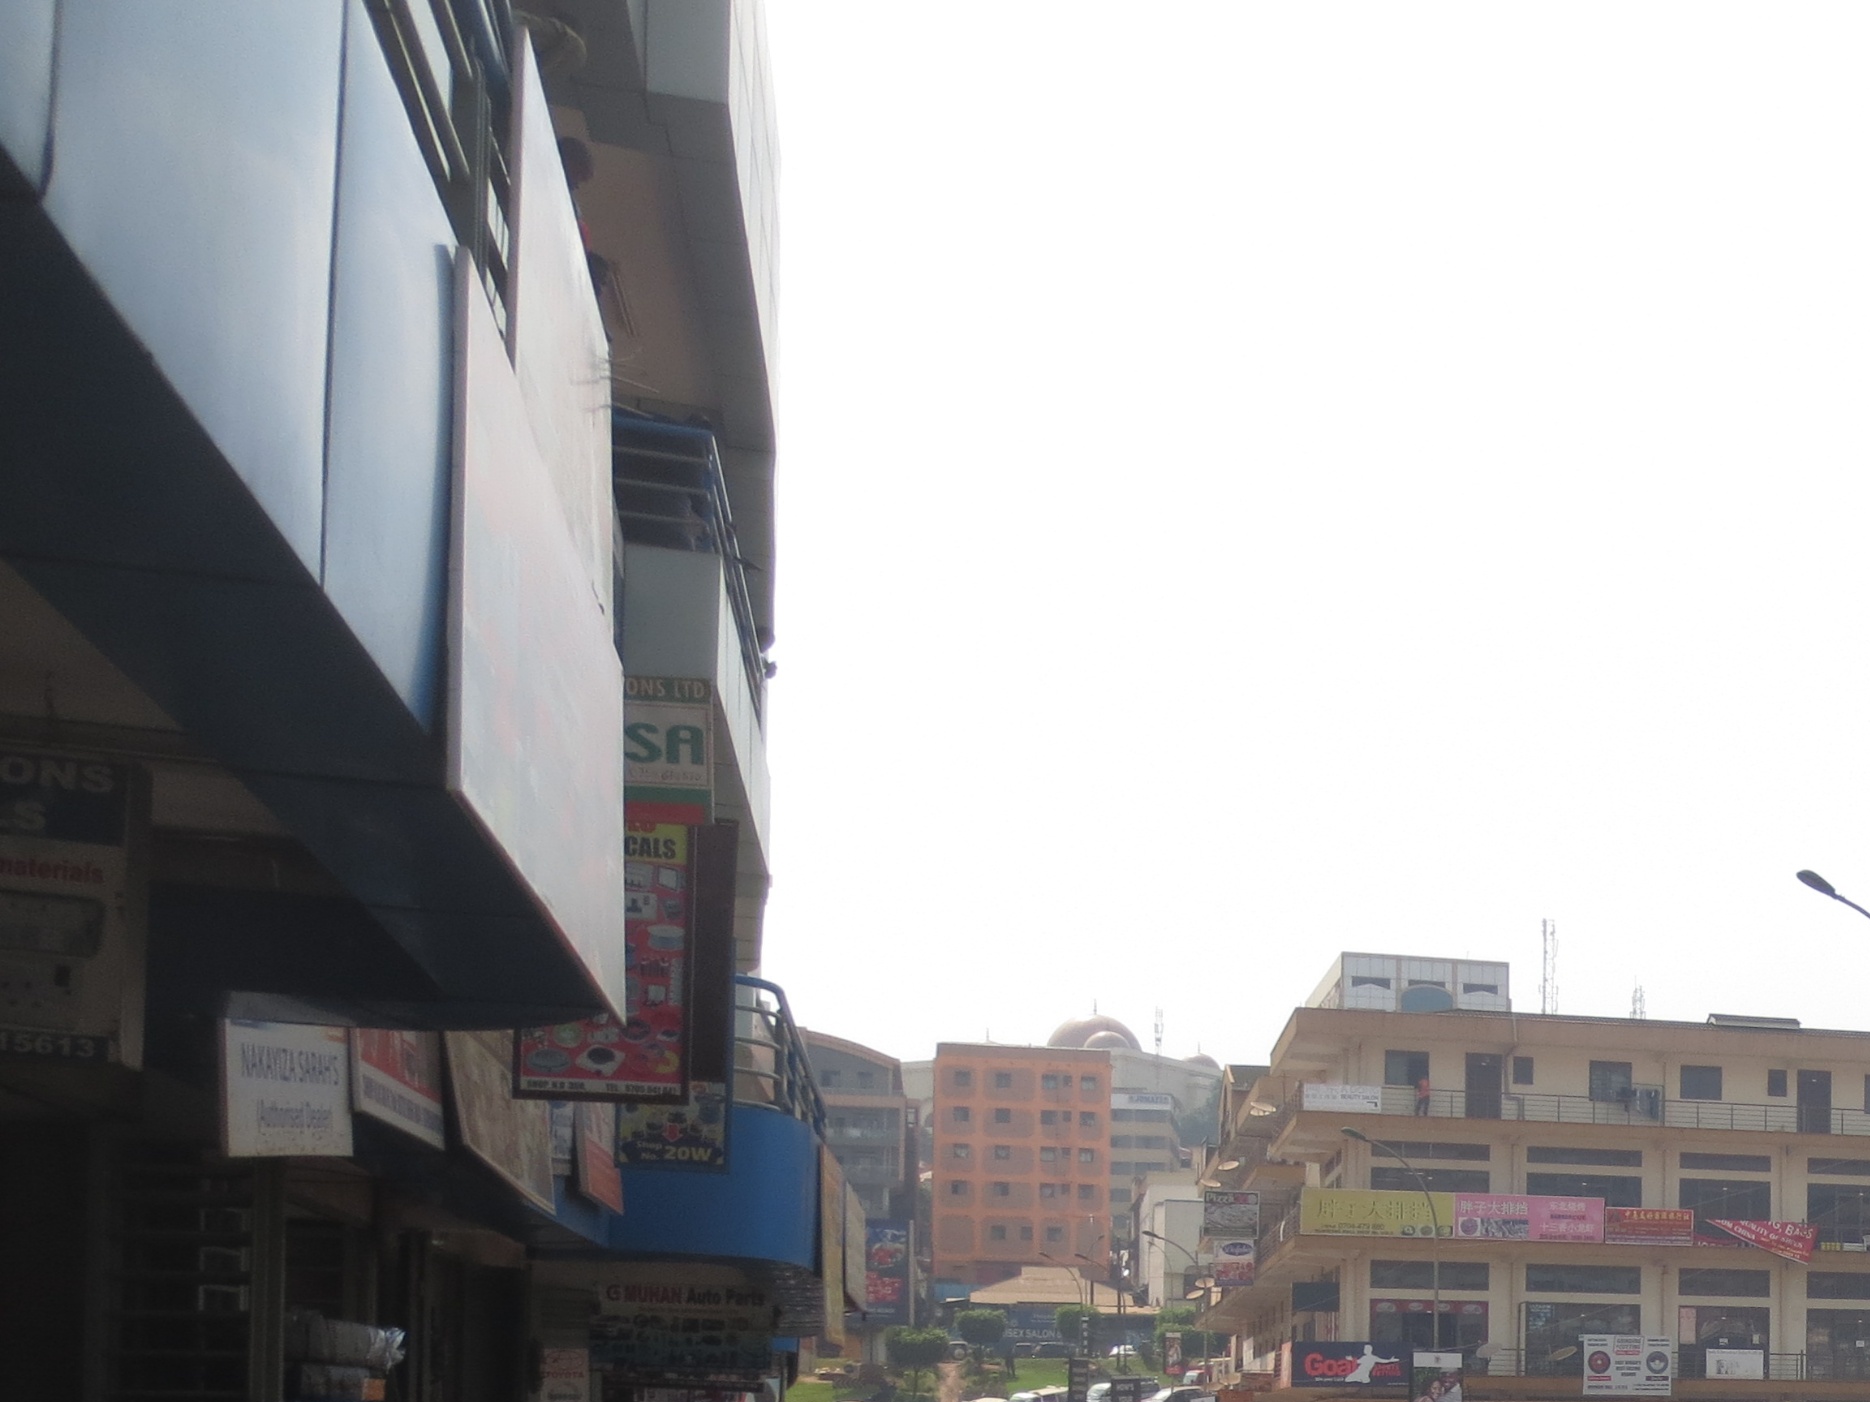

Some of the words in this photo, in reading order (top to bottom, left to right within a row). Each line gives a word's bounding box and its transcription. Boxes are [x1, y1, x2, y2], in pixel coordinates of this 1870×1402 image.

[673, 679, 704, 699] LTD
[636, 1141, 662, 1151] Shop
[665, 1146, 712, 1161] 20W
[687, 1288, 721, 1304] Auto
[1025, 1329, 1055, 1338] SALON
